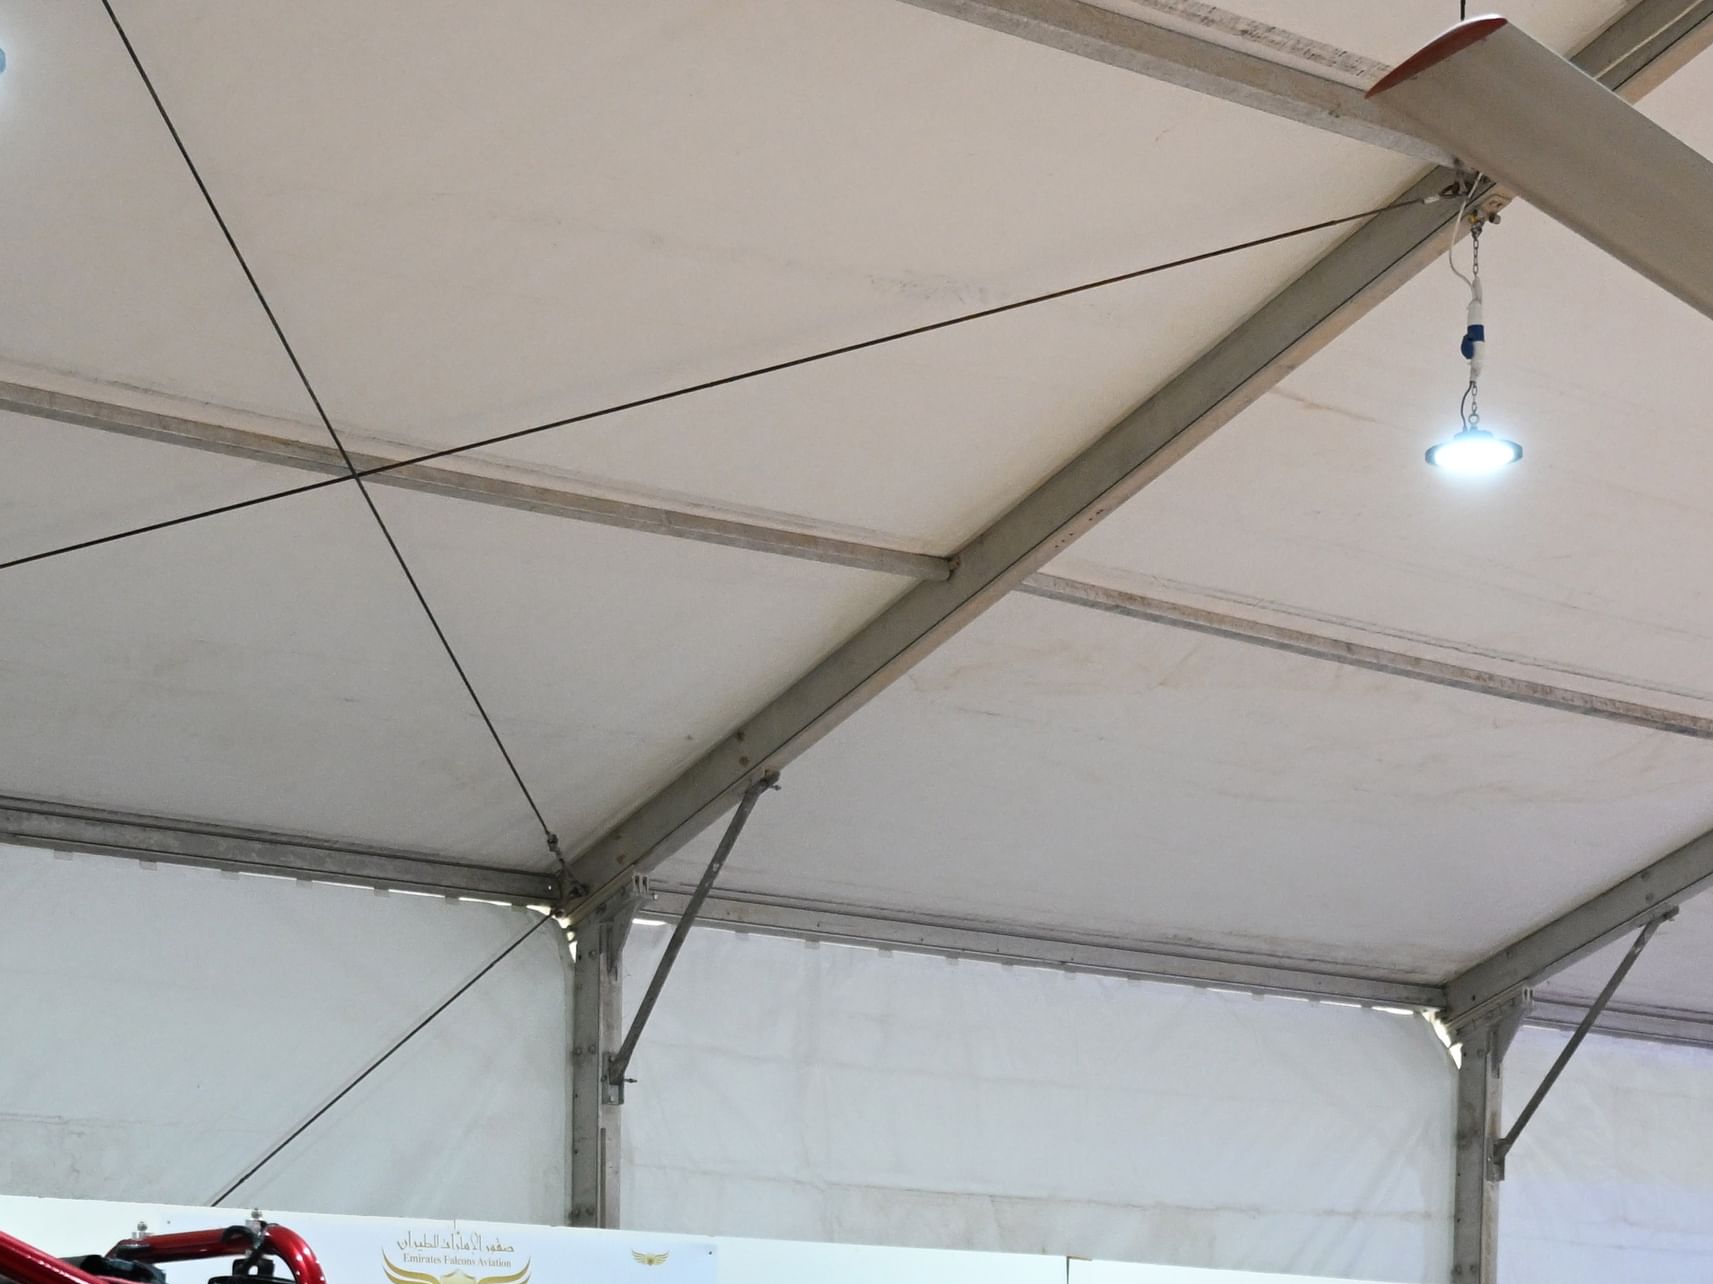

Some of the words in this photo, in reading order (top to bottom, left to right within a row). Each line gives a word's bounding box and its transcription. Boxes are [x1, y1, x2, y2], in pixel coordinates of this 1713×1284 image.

[403, 1253, 442, 1265] Emirates
[444, 1256, 476, 1267] Falcons
[478, 1258, 512, 1268] Aviation
